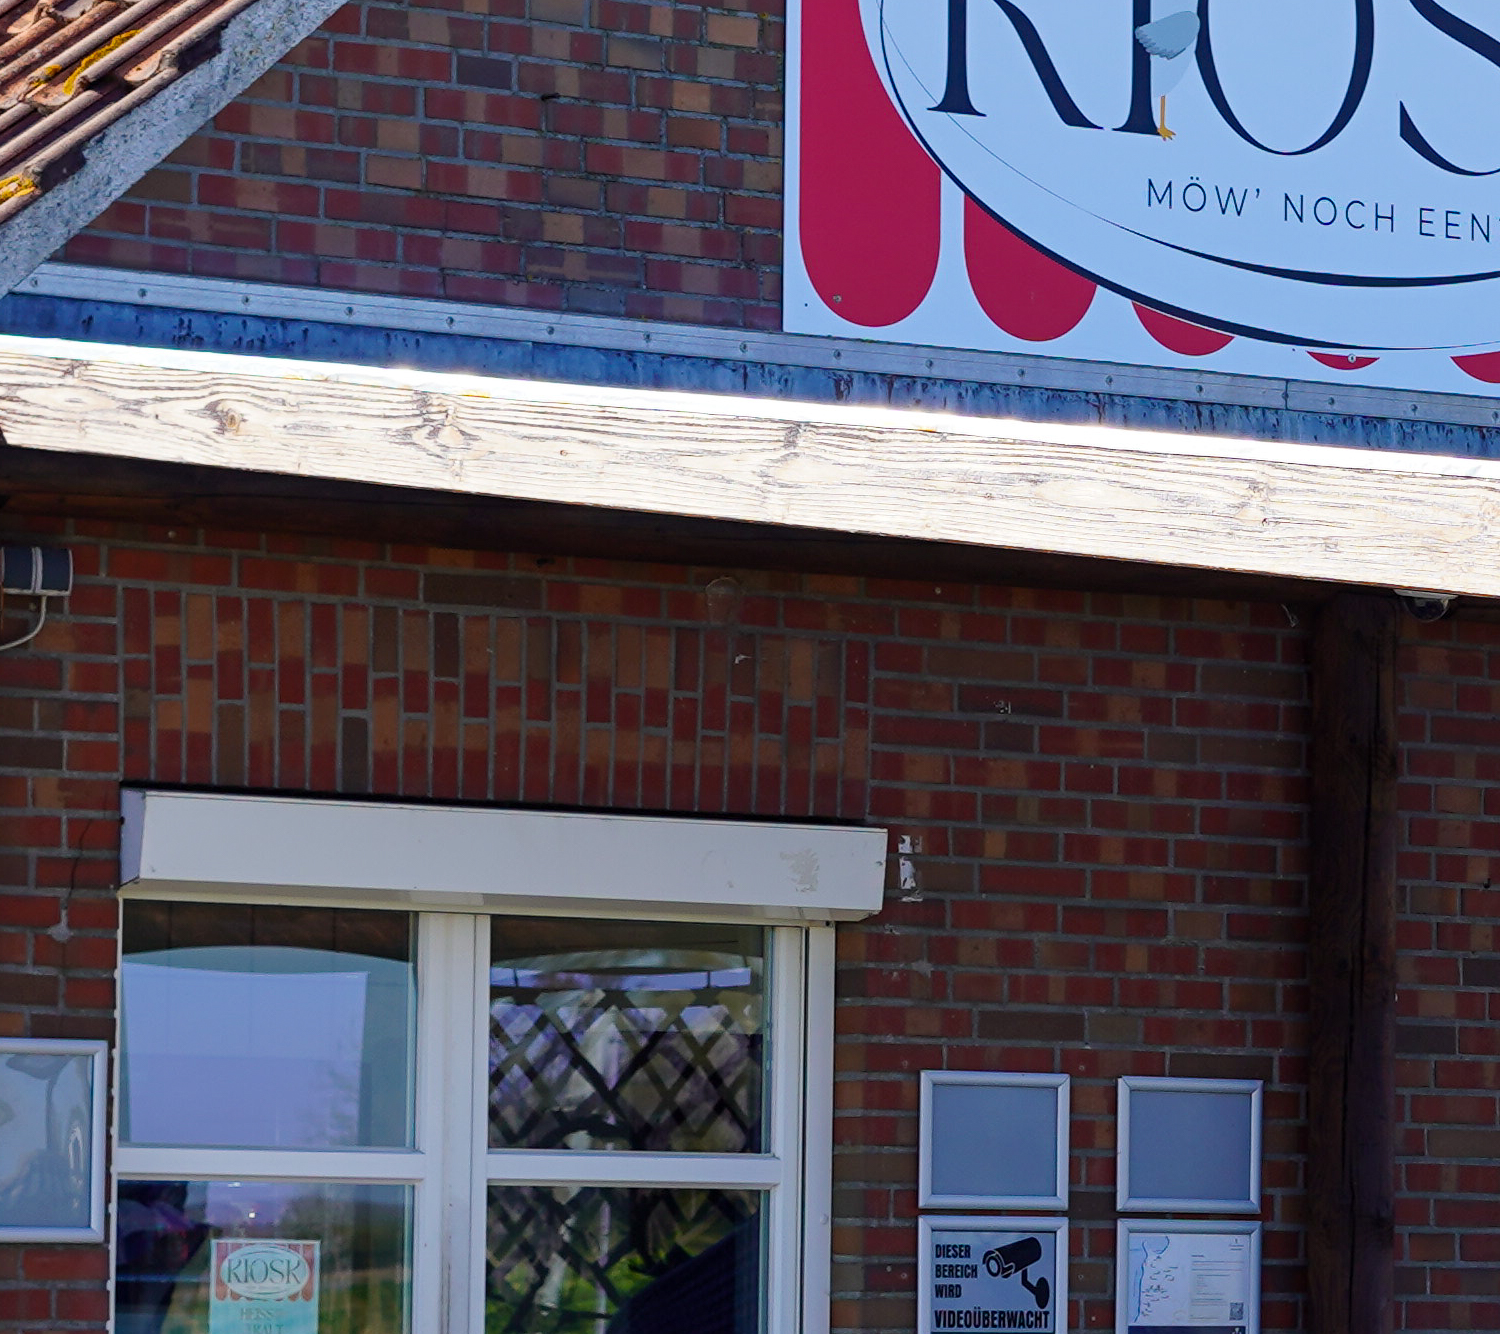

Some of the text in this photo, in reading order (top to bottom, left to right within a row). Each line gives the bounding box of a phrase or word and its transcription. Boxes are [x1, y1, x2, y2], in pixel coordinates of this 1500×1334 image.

[1283, 192, 1395, 233] NOCH
[935, 1244, 971, 1259] DIESER
[227, 1258, 301, 1285] KIOSK
[935, 1264, 978, 1279] BEREICH
[934, 1284, 962, 1299] WIRD
[934, 1306, 1050, 1329] VIDEOÜBERWACHT
